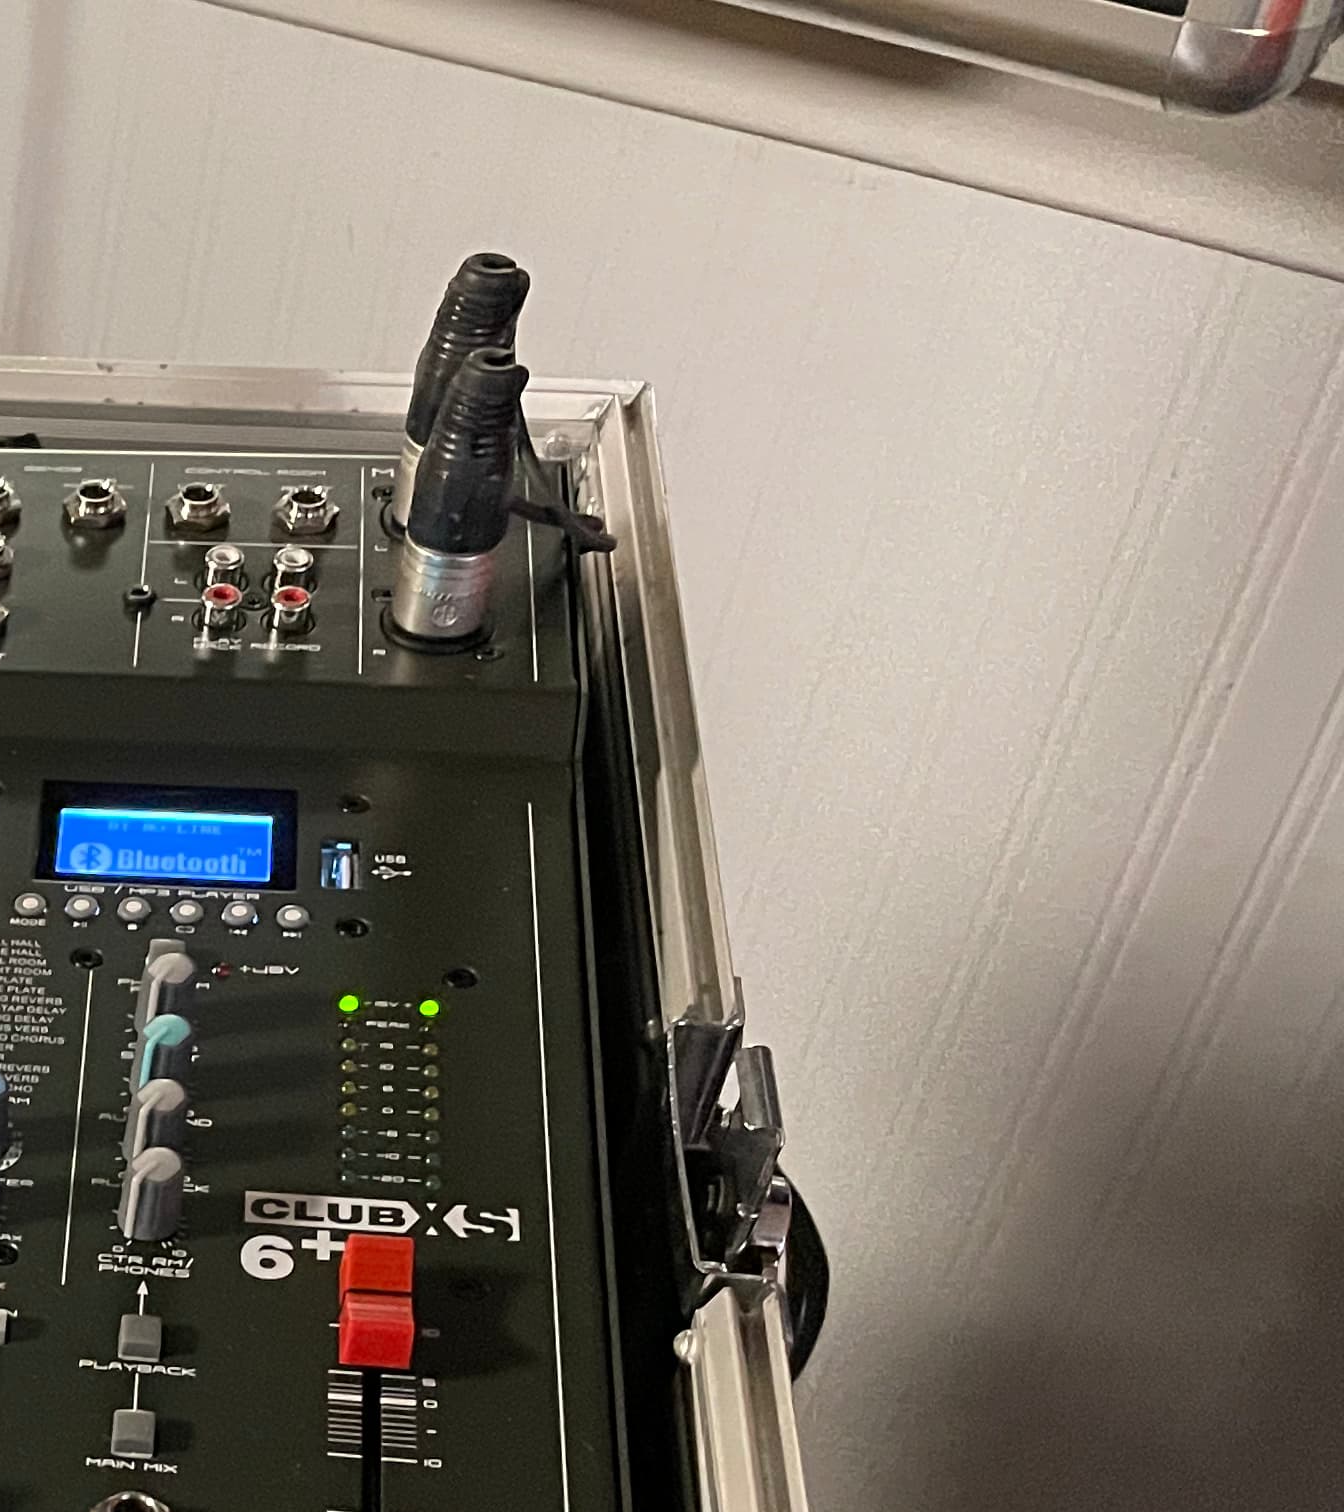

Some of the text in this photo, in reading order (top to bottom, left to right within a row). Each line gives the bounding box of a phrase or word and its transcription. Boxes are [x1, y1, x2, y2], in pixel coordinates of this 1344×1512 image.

[116, 848, 248, 876] Bluetooth
[374, 853, 407, 865] USB
[9, 916, 47, 927] MODE
[10, 938, 41, 949] HALL
[10, 948, 42, 958] HALL
[8, 957, 48, 967] ROOM
[13, 966, 53, 977] ROOM
[6, 985, 46, 995] PLATE
[11, 995, 64, 1006] REVERB
[26, 1005, 68, 1016] DELAY
[14, 1014, 55, 1025] DELAY
[14, 1024, 49, 1034] VERB
[10, 1033, 66, 1045] CHORUS
[249, 1197, 406, 1228] CLUB
[97, 1252, 144, 1266] CTR
[98, 1263, 192, 1279] PHONES
[78, 1358, 197, 1378] PLAYBACK
[422, 1399, 439, 1409] 0
[85, 1456, 178, 1474] MAIN MIX
[423, 1458, 443, 1469] 10
